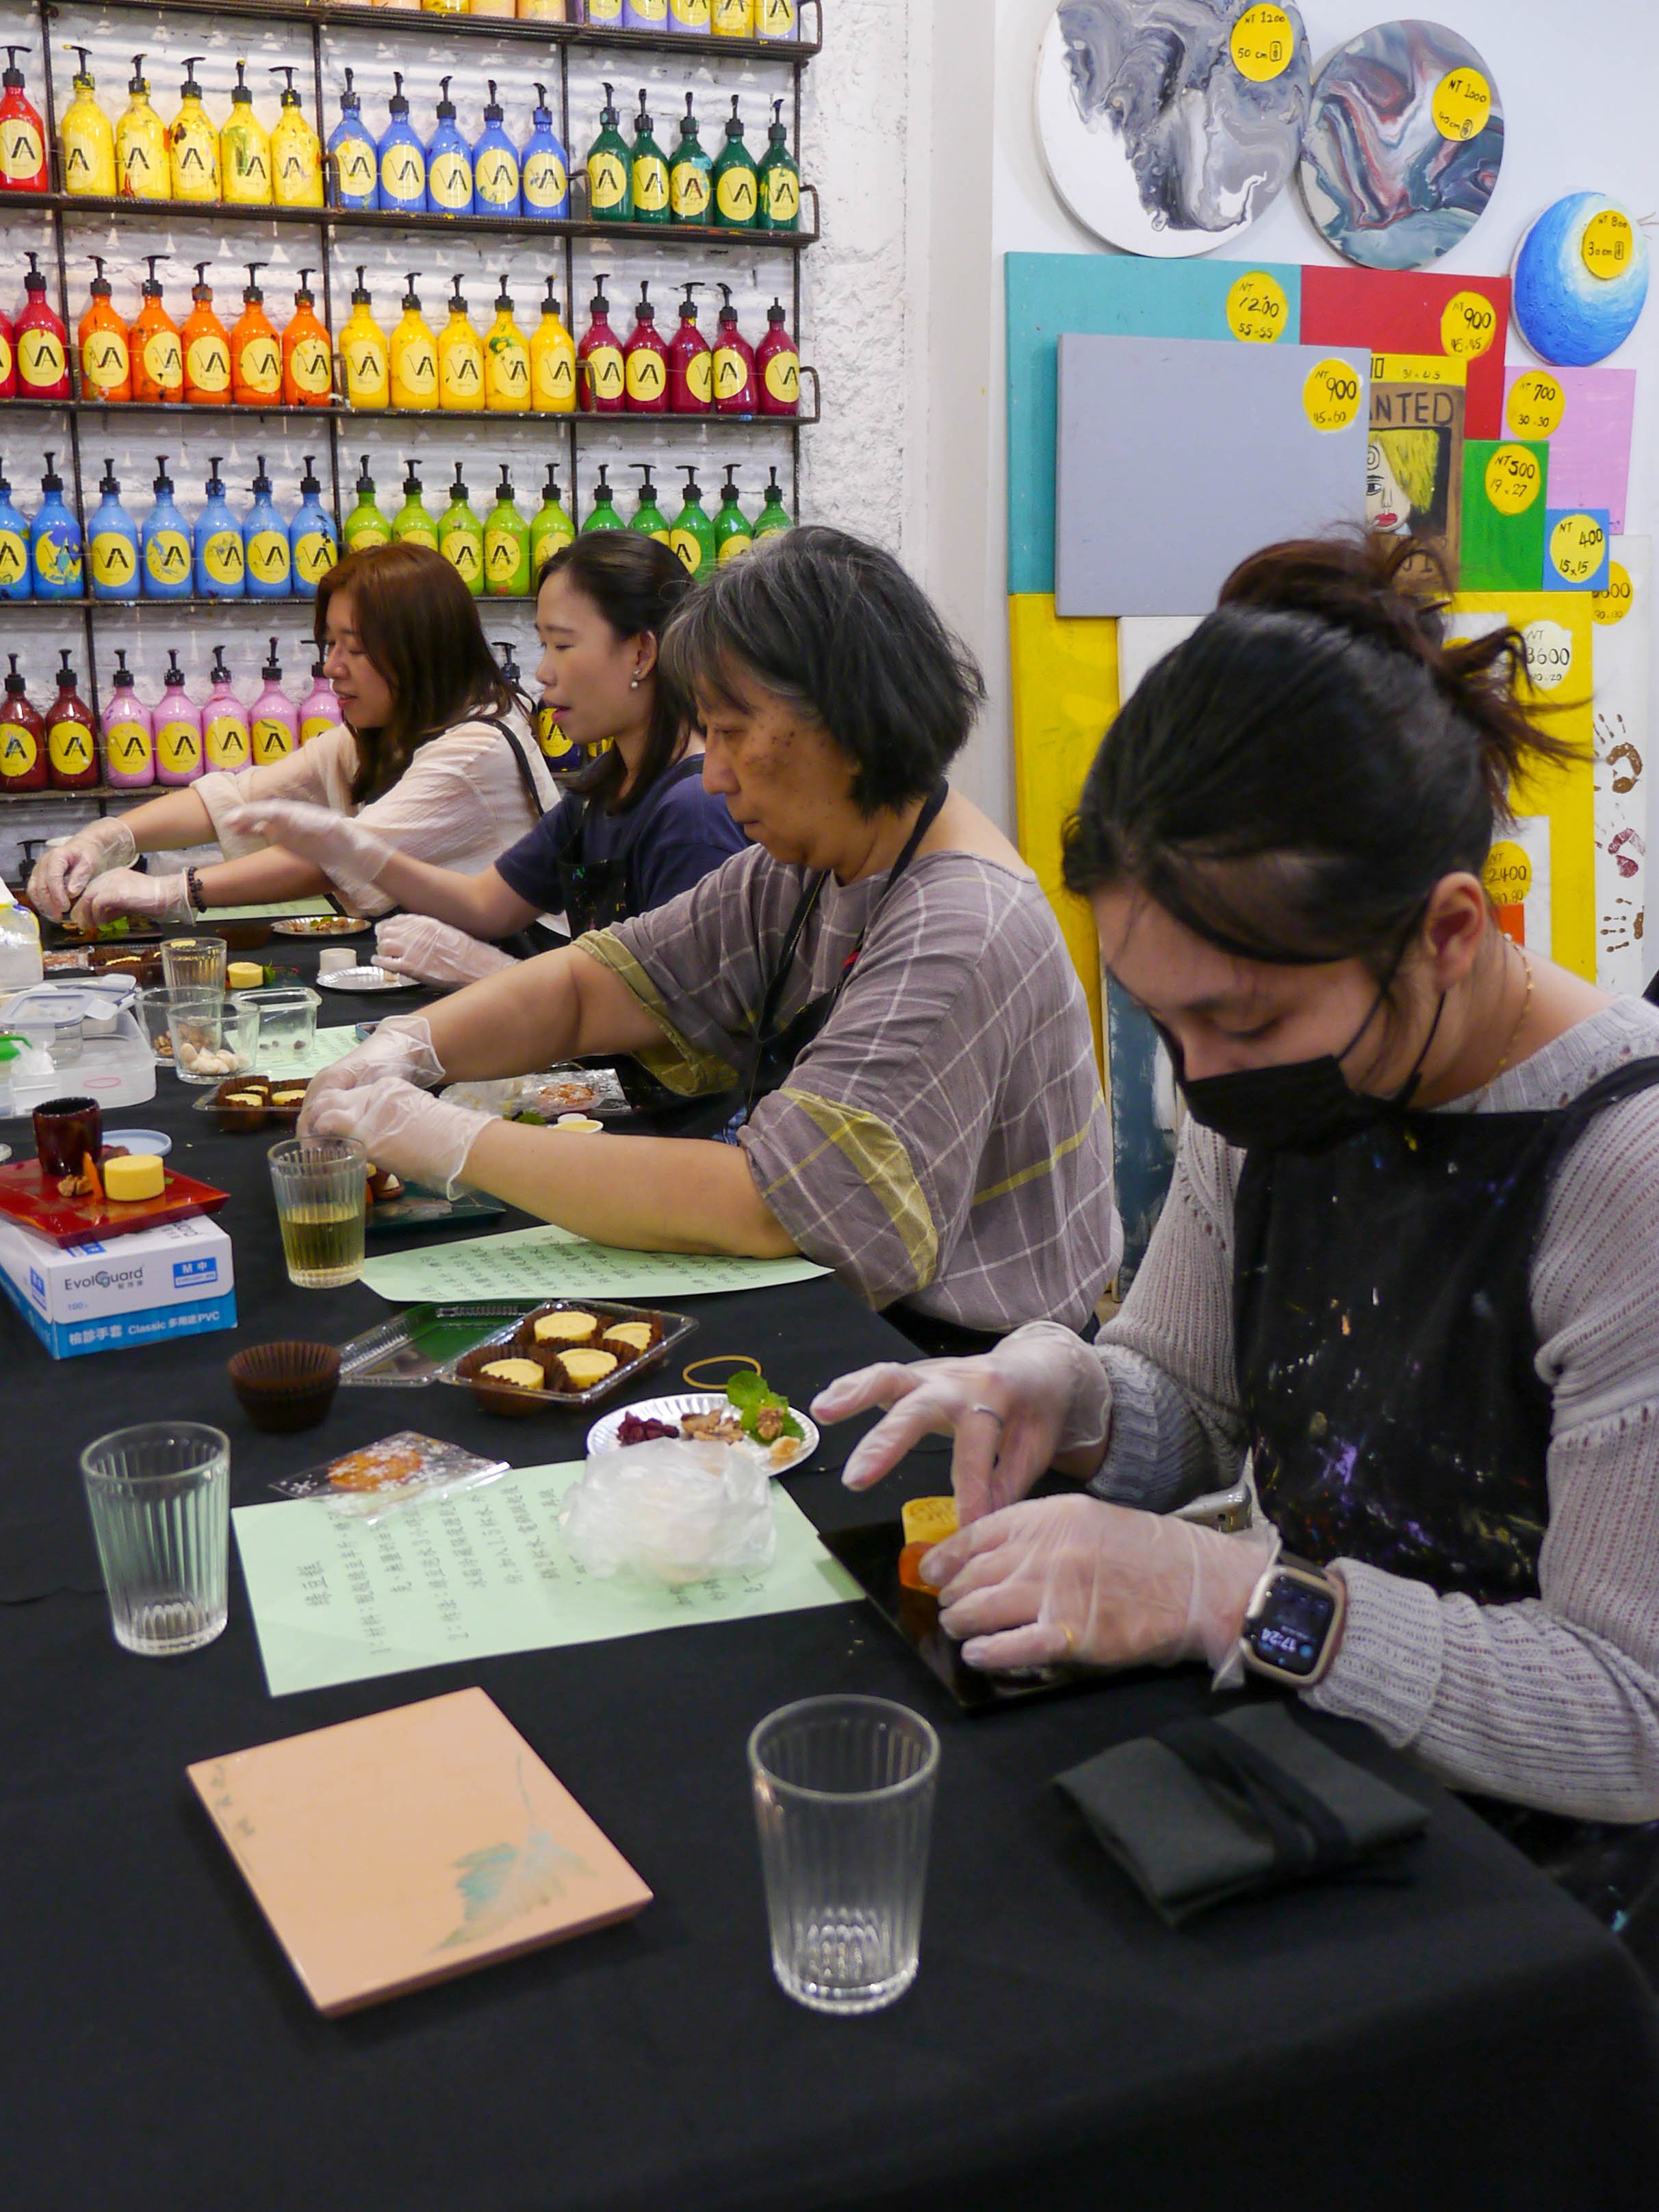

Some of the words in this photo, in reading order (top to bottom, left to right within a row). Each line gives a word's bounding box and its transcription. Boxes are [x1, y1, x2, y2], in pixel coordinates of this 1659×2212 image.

[1261, 11, 1285, 23] 1200
[1238, 47, 1251, 59] 50
[1448, 79, 1463, 93] NT
[1464, 83, 1487, 103] 1000
[1239, 283, 1254, 292] NT
[1239, 296, 1279, 318] 1200
[1464, 307, 1491, 329] 900
[1315, 370, 1329, 379] NT
[1326, 377, 1357, 401] 900
[1533, 384, 1556, 401] 700
[1495, 456, 1511, 466] NT
[1508, 461, 1535, 479] 500
[1560, 522, 1573, 532] NT
[1579, 528, 1603, 548] 400
[1527, 630, 1544, 641] NT
[1527, 647, 1570, 665] 3600
[1489, 865, 1527, 882] 2400
[182, 1263, 193, 1274] M
[196, 1261, 207, 1271] 中
[128, 1321, 166, 1335] Classic
